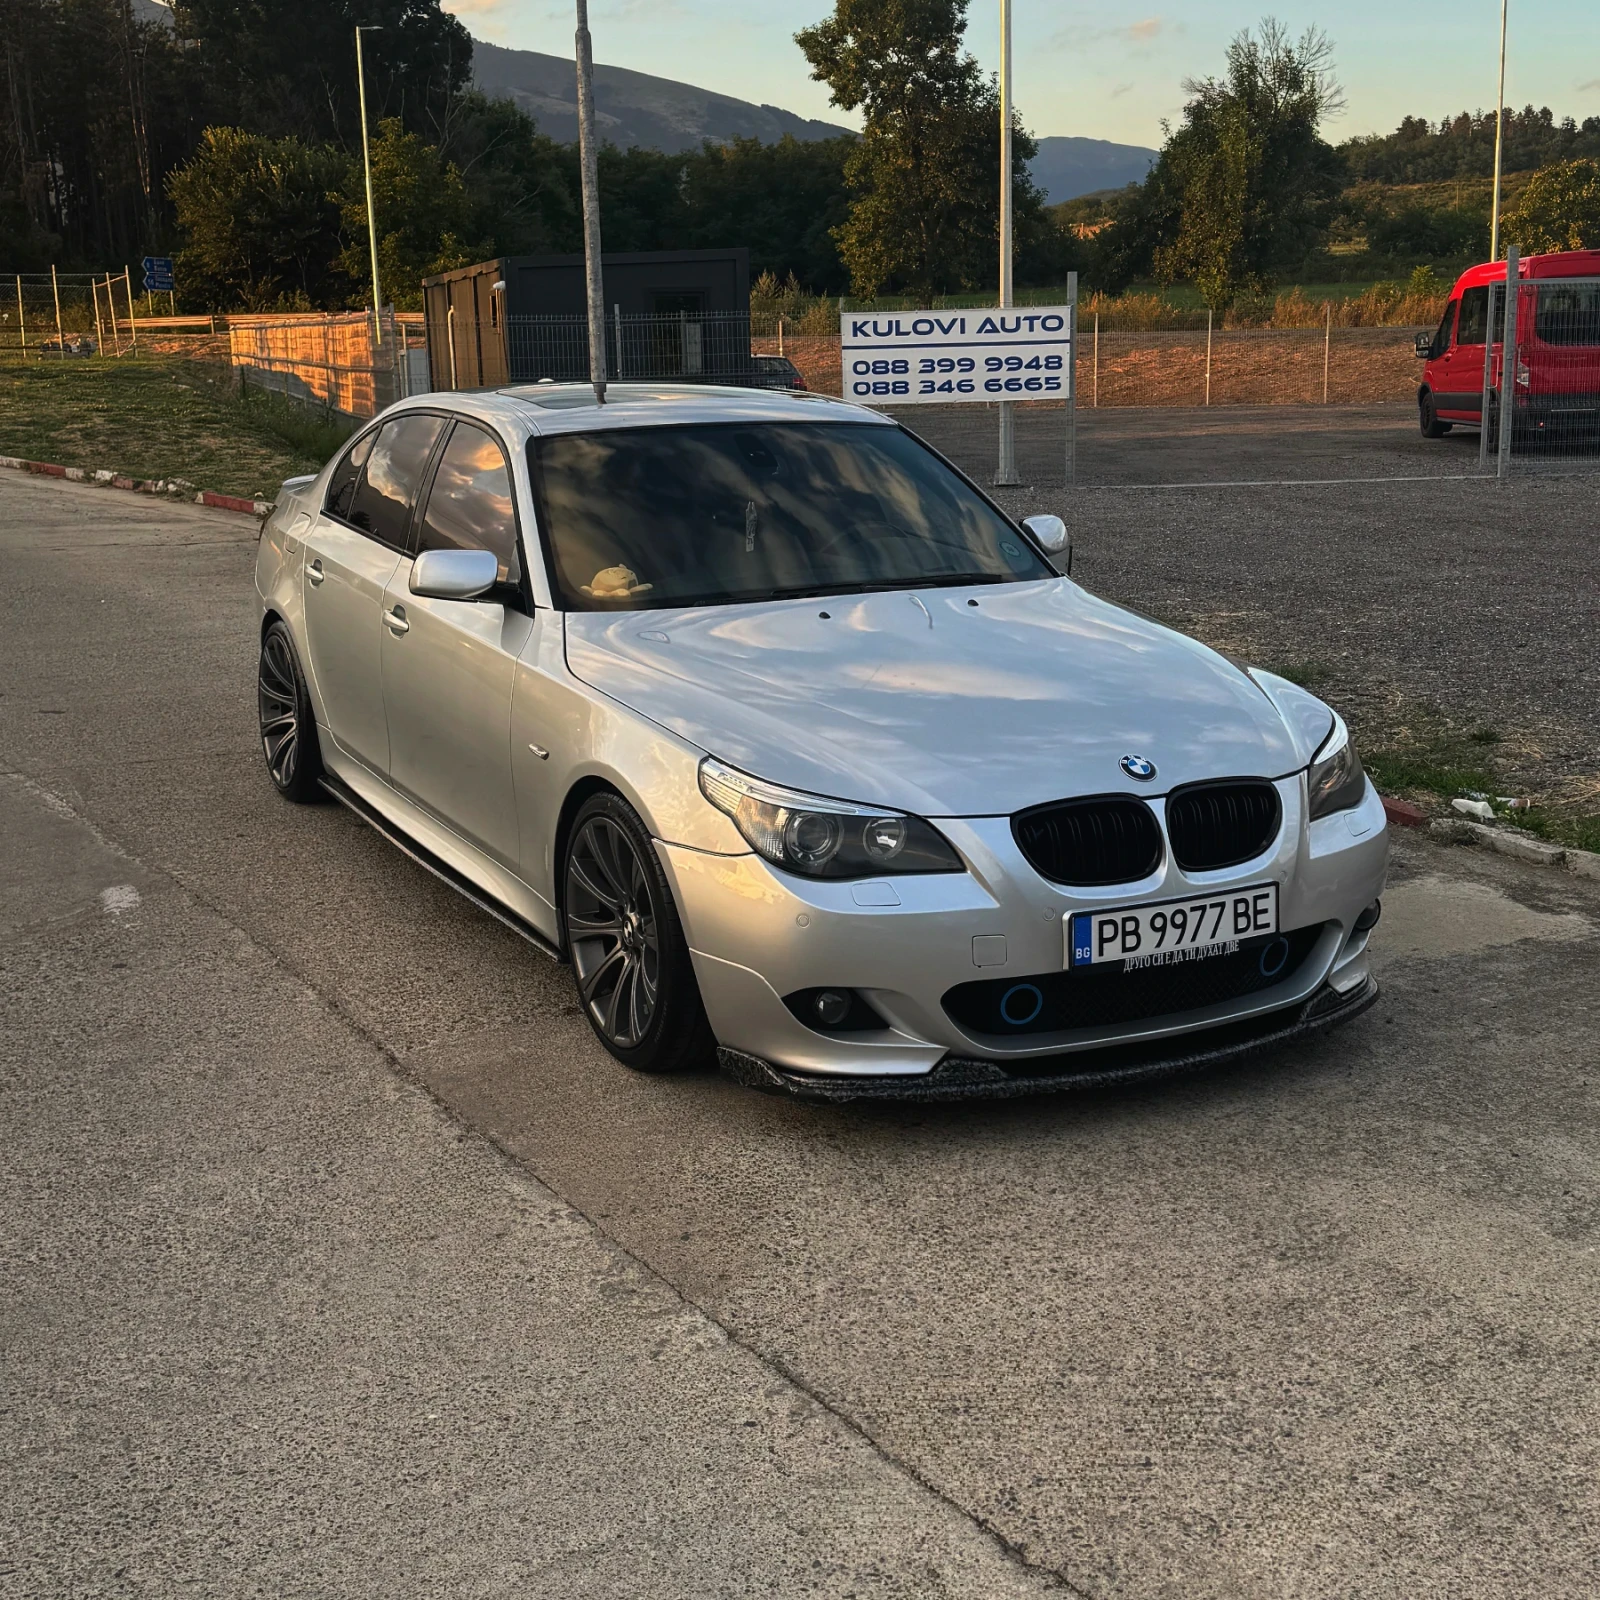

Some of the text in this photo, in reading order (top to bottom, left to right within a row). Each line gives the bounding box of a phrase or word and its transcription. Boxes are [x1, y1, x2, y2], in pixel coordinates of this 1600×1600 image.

[852, 315, 1064, 337] KULOVI AUTO
[852, 355, 1063, 376] 088 399 9948
[853, 376, 1062, 395] 088 346 6665
[1098, 893, 1270, 957] PB 9977 BE
[1075, 947, 1090, 959] BG
[1123, 940, 1240, 974] ДРУГО СИ Е ДА ТИ ДУХАТ ДВЕ
